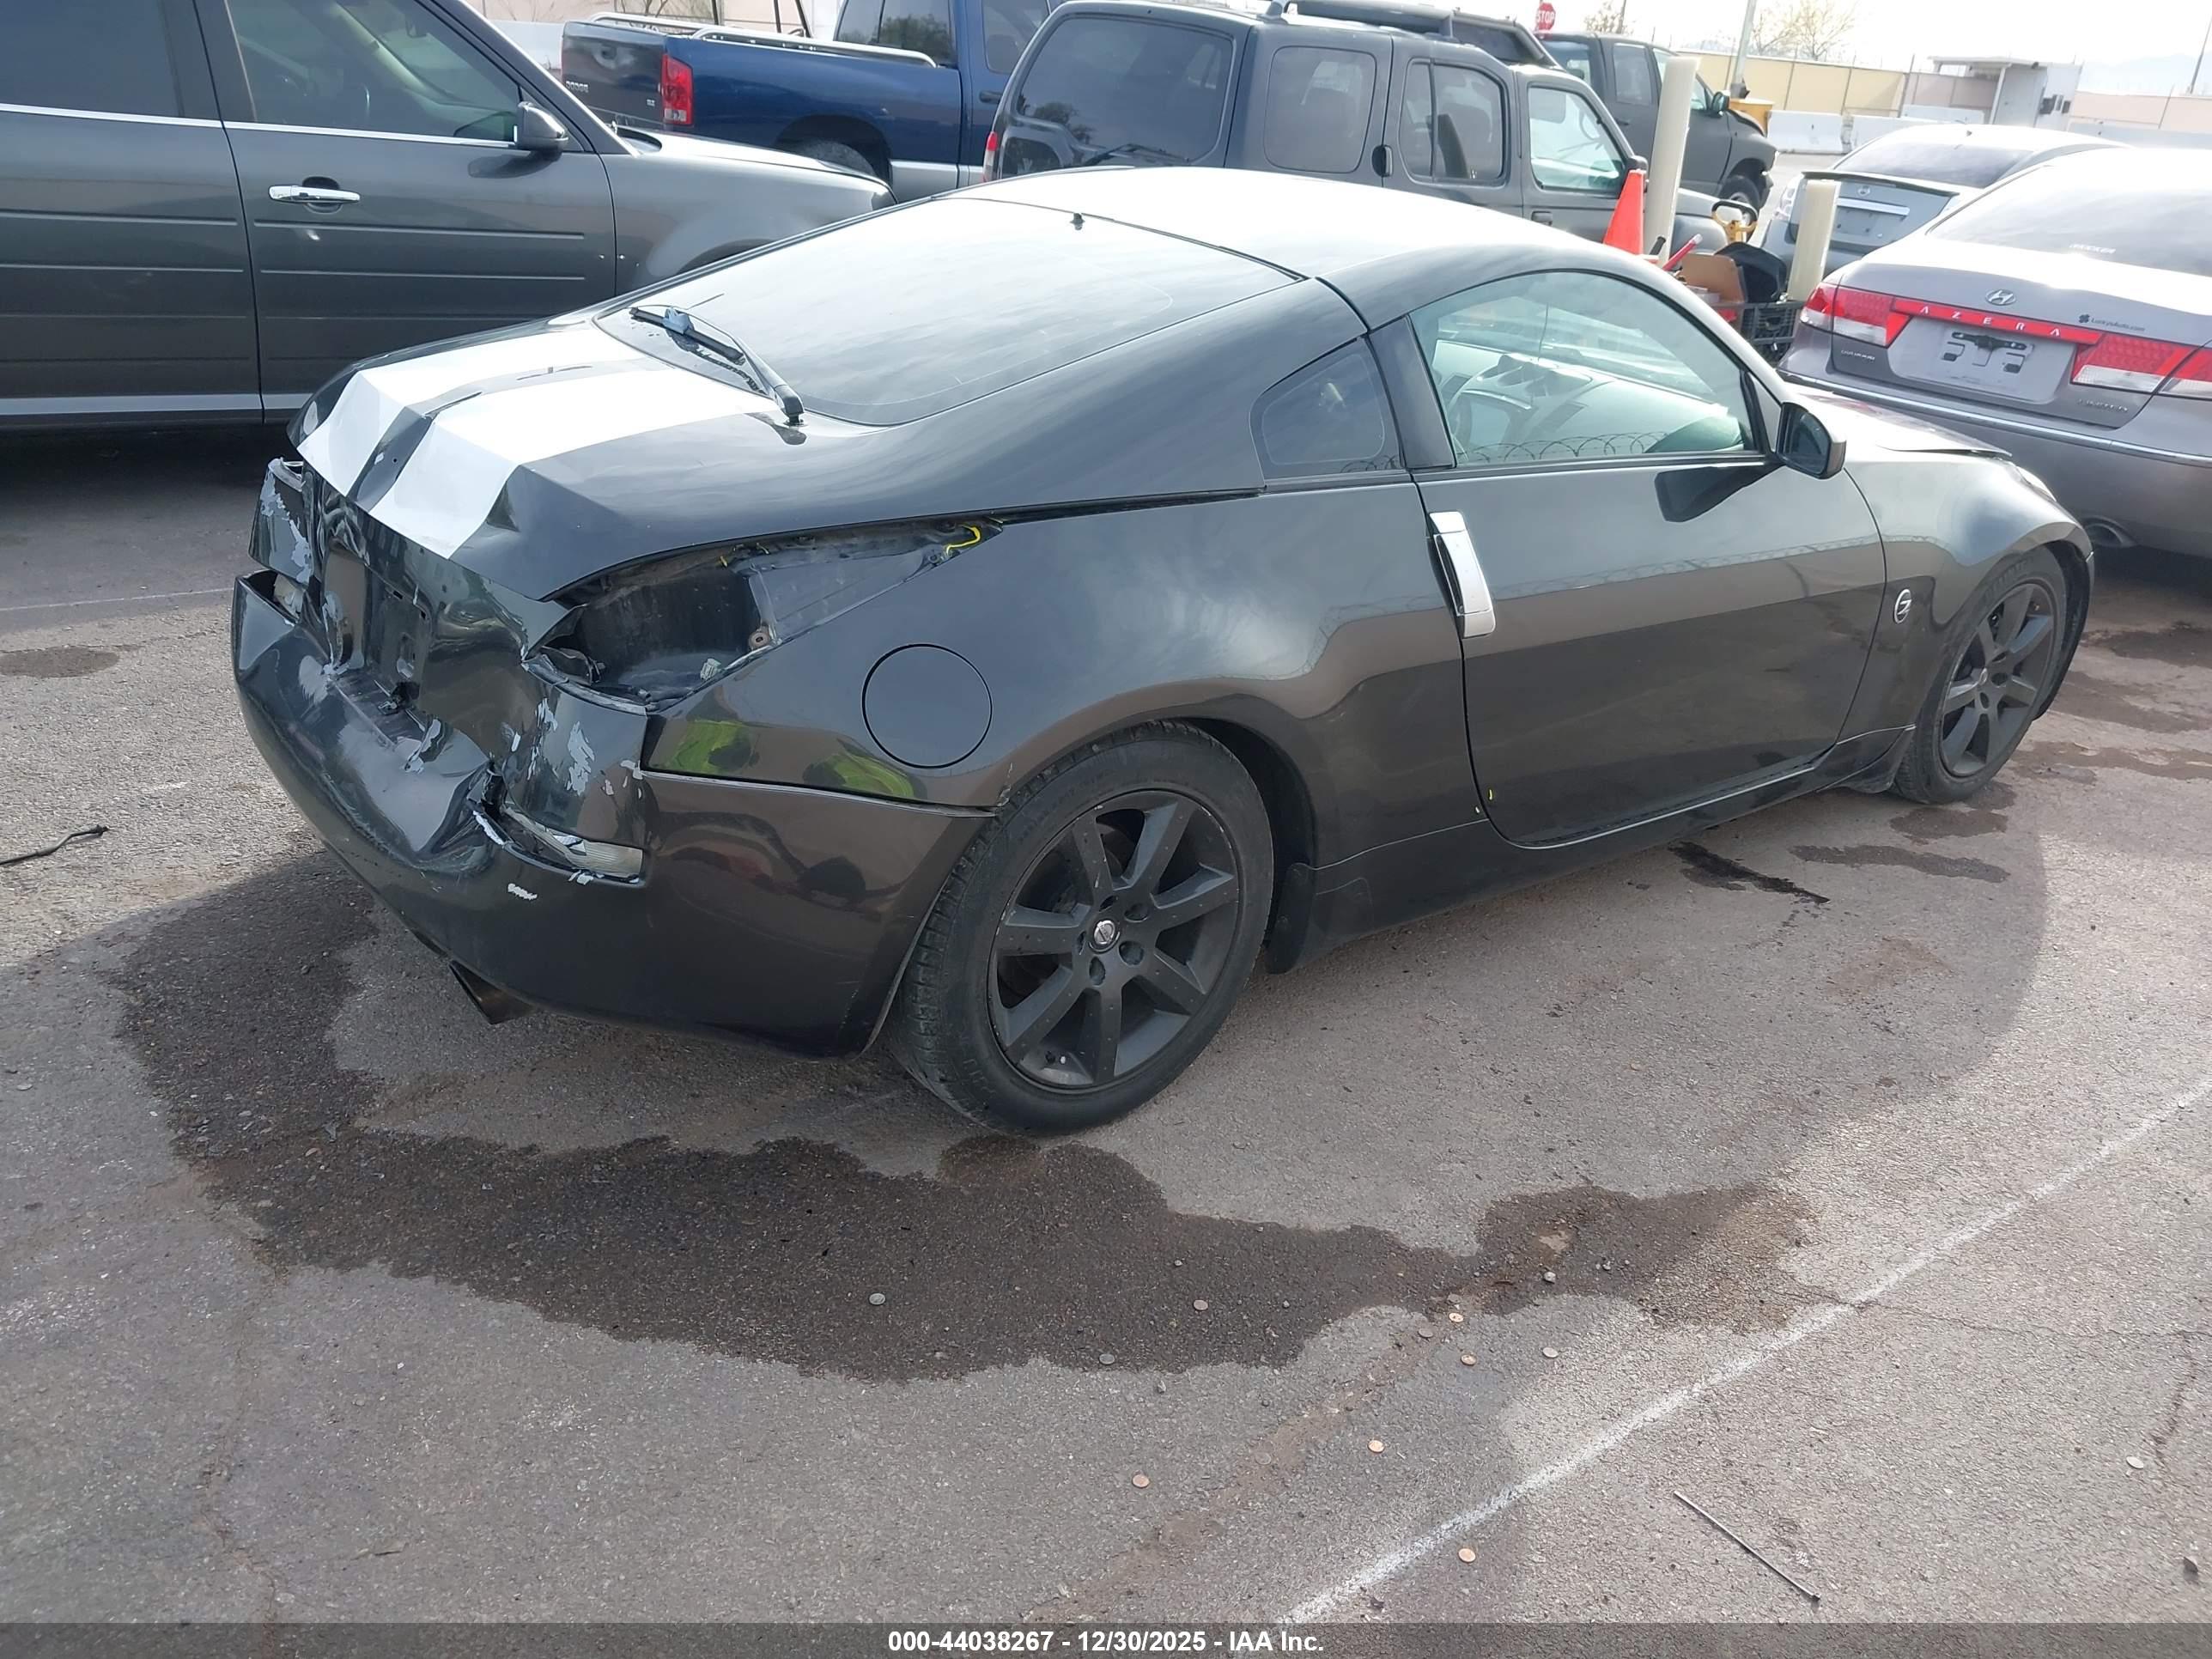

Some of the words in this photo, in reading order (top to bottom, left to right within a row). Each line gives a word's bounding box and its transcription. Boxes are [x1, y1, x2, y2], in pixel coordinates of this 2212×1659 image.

[1537, 10, 1555, 23] STOP
[565, 81, 589, 93] DODGE
[1920, 306, 2060, 337] AZERA
